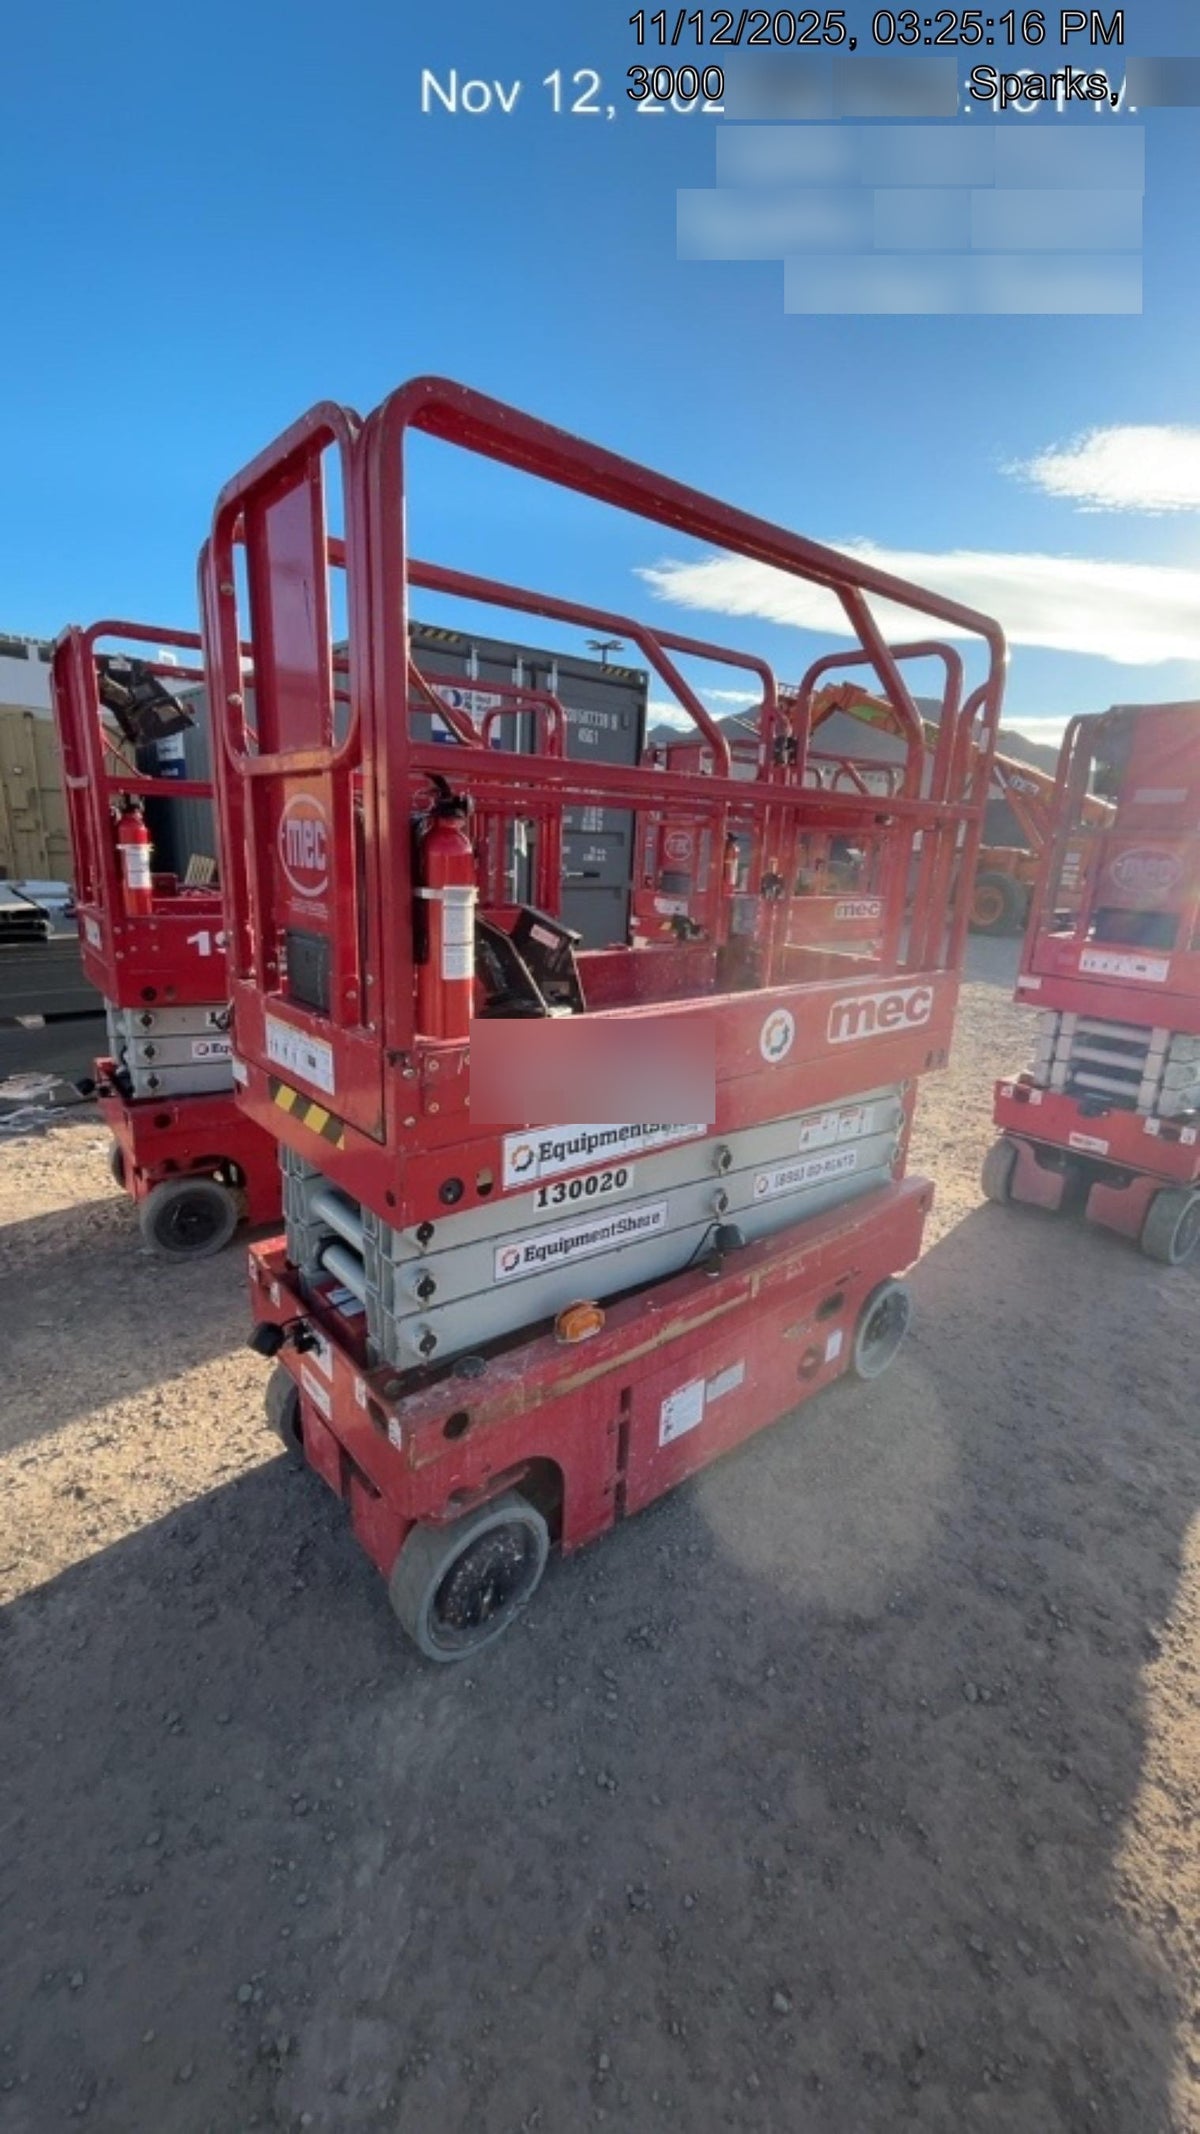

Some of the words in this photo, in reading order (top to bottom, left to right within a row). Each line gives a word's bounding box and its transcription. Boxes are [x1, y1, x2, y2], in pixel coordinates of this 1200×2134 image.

[285, 819, 327, 870] mec
[828, 988, 931, 1040] mec
[537, 1168, 628, 1209] 130020
[523, 1212, 662, 1263] EquipmentShare
